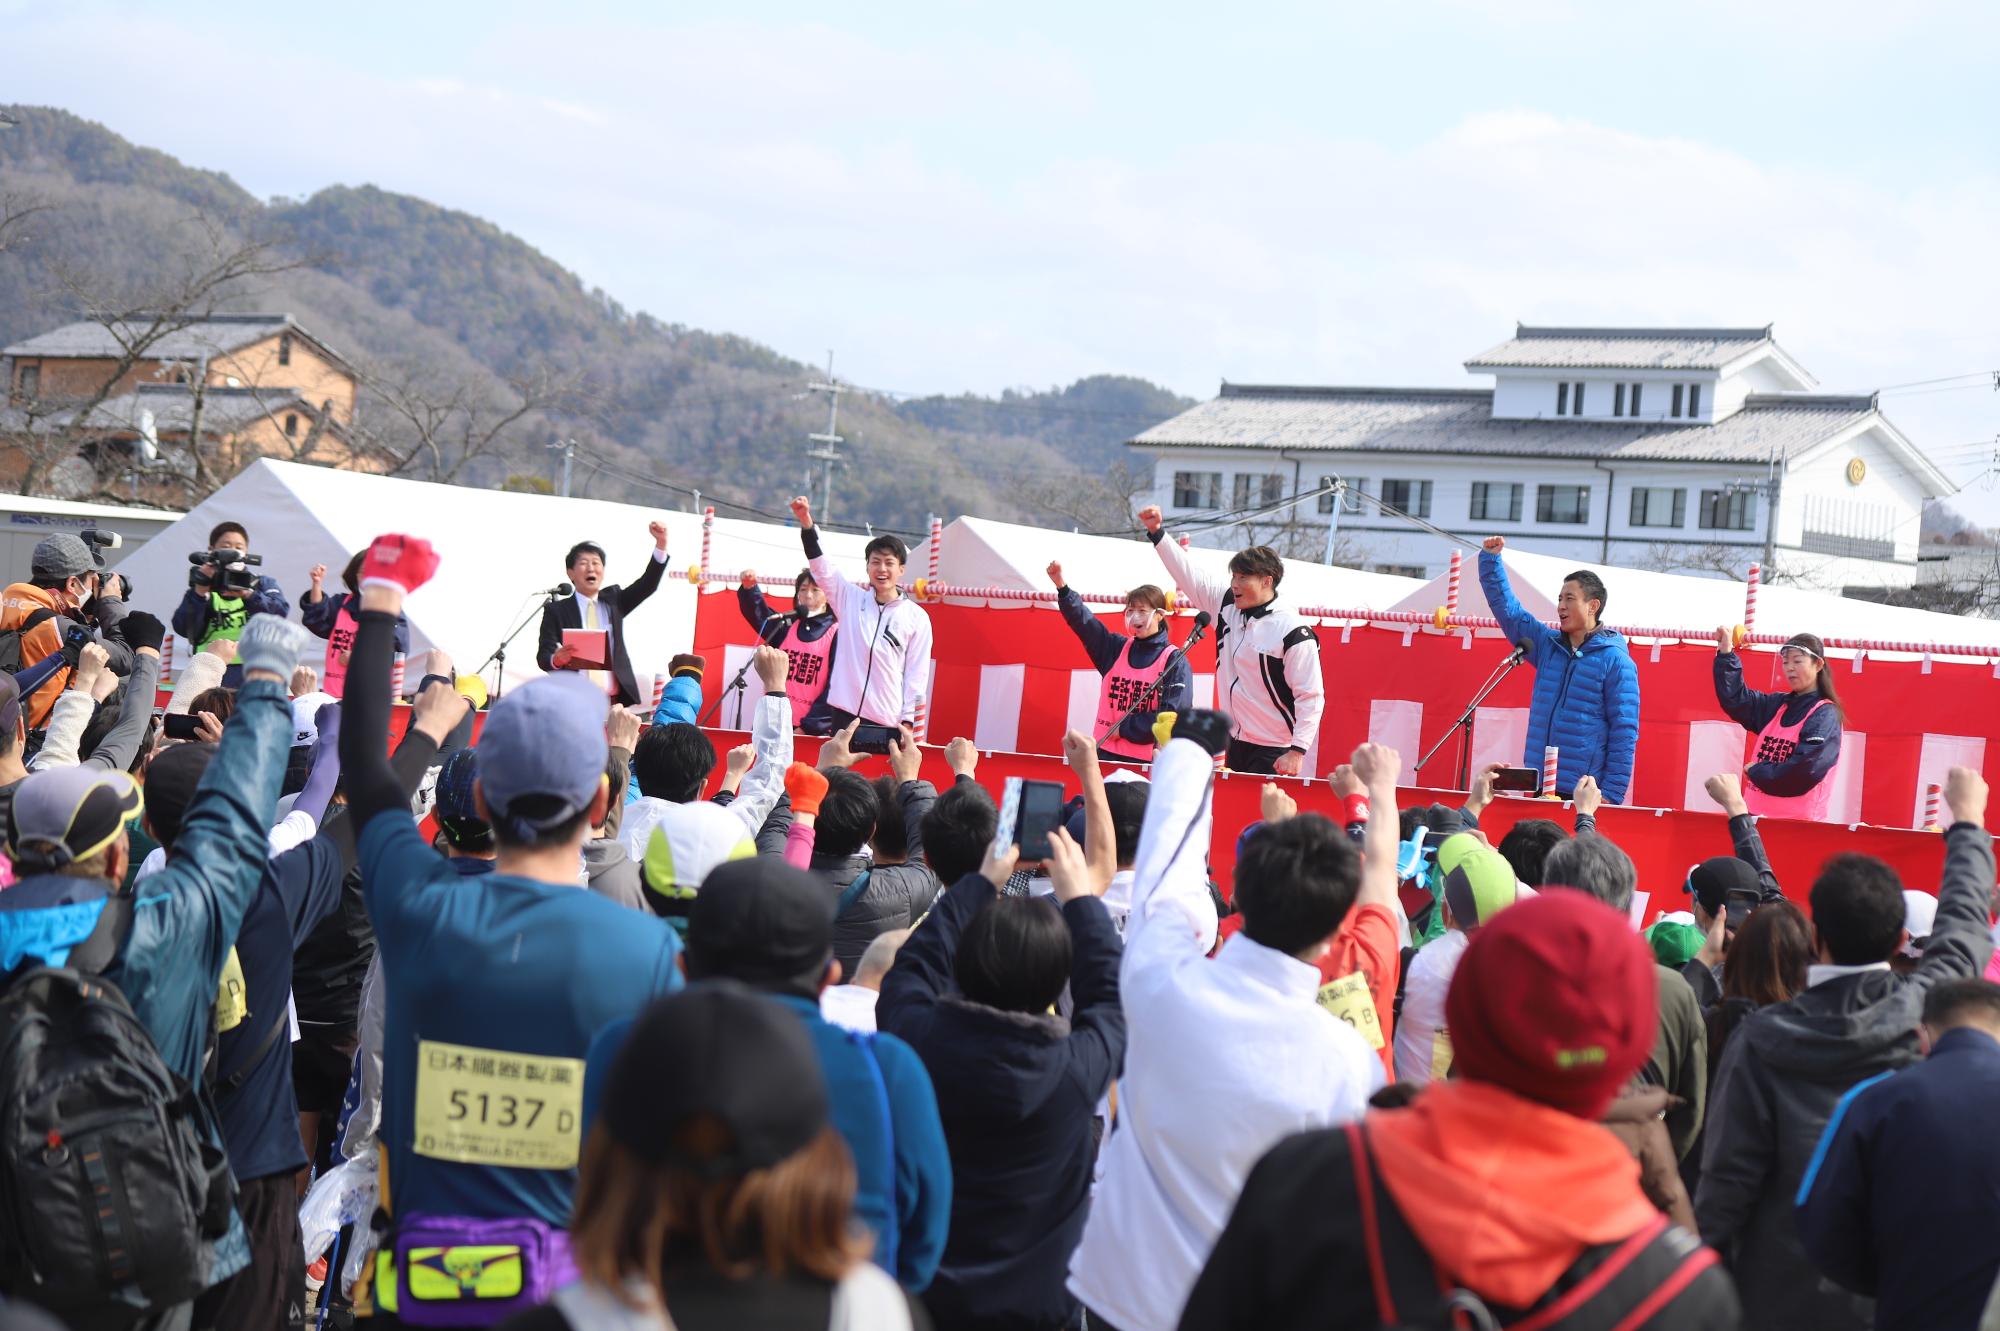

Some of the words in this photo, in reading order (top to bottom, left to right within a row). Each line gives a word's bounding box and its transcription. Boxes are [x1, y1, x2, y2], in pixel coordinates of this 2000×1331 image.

[1362, 1006, 1374, 1024] B
[447, 1089, 546, 1130] 5137
[556, 1109, 574, 1134] D
